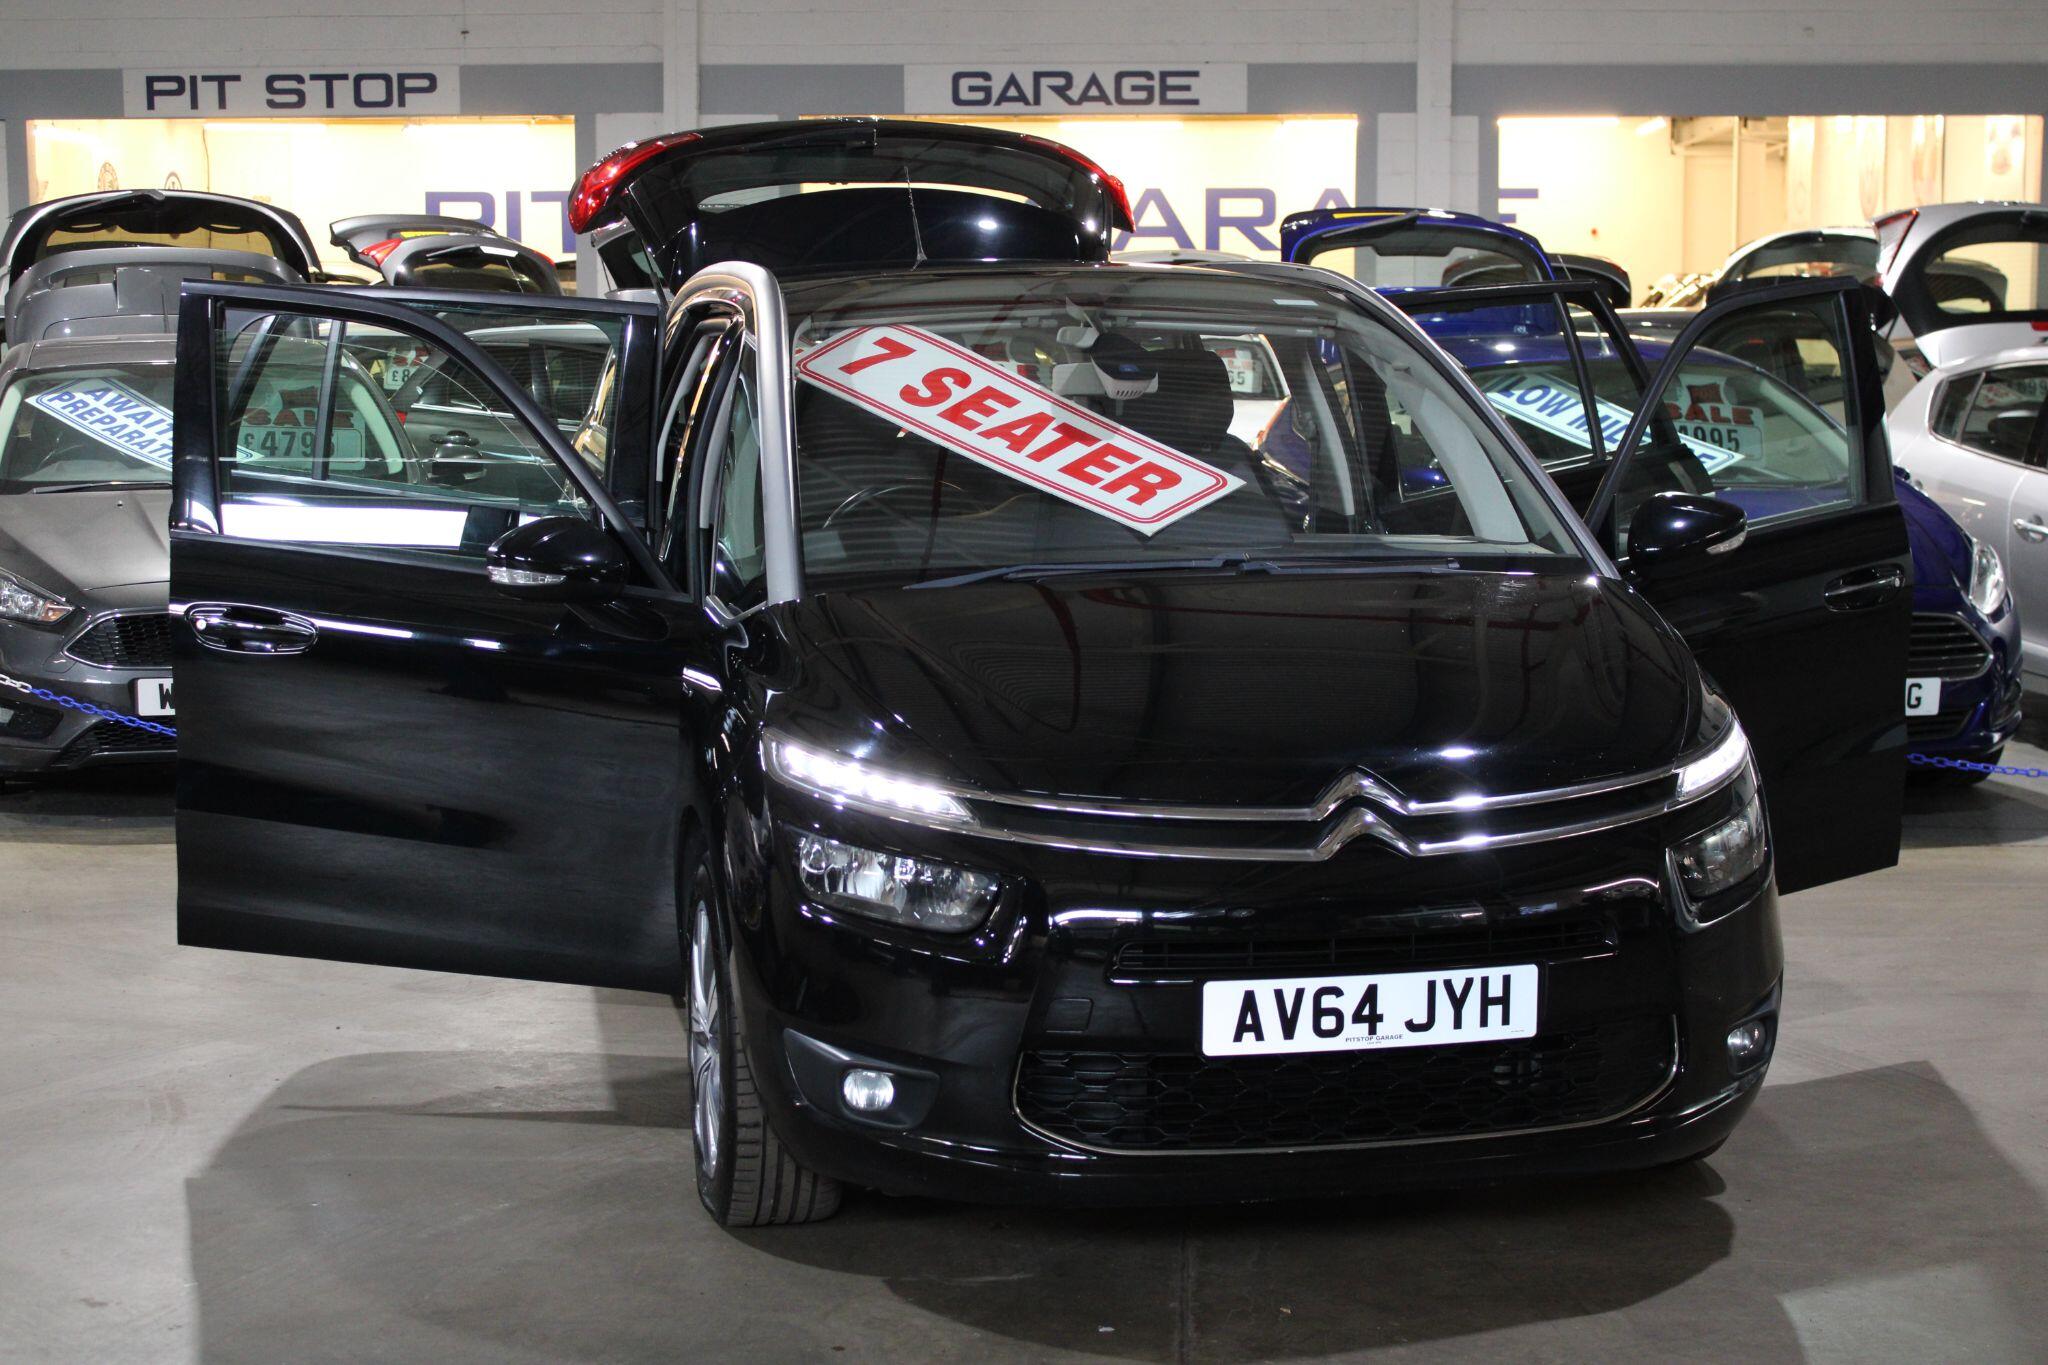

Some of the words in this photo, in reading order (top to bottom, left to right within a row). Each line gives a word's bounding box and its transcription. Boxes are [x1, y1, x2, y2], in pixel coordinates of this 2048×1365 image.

[145, 74, 241, 110] PIT
[265, 73, 437, 109] STOP
[951, 70, 1200, 106] GARAGE
[425, 190, 577, 253] PIT
[391, 368, 410, 382] £8
[84, 387, 174, 441] AWAIT
[1499, 374, 1580, 418] LOW
[1663, 402, 1754, 425] SALE
[47, 391, 174, 461] PREPARATI
[838, 336, 916, 376] 7
[899, 367, 1182, 506] SEATER
[244, 431, 335, 457] £479
[159, 683, 176, 709] W
[1907, 682, 1922, 708] G
[1232, 983, 1384, 1042] AV64
[1404, 974, 1512, 1033] JYH
[1345, 1035, 1374, 1043] PITSTOP
[1375, 1033, 1403, 1041] GARAGE
